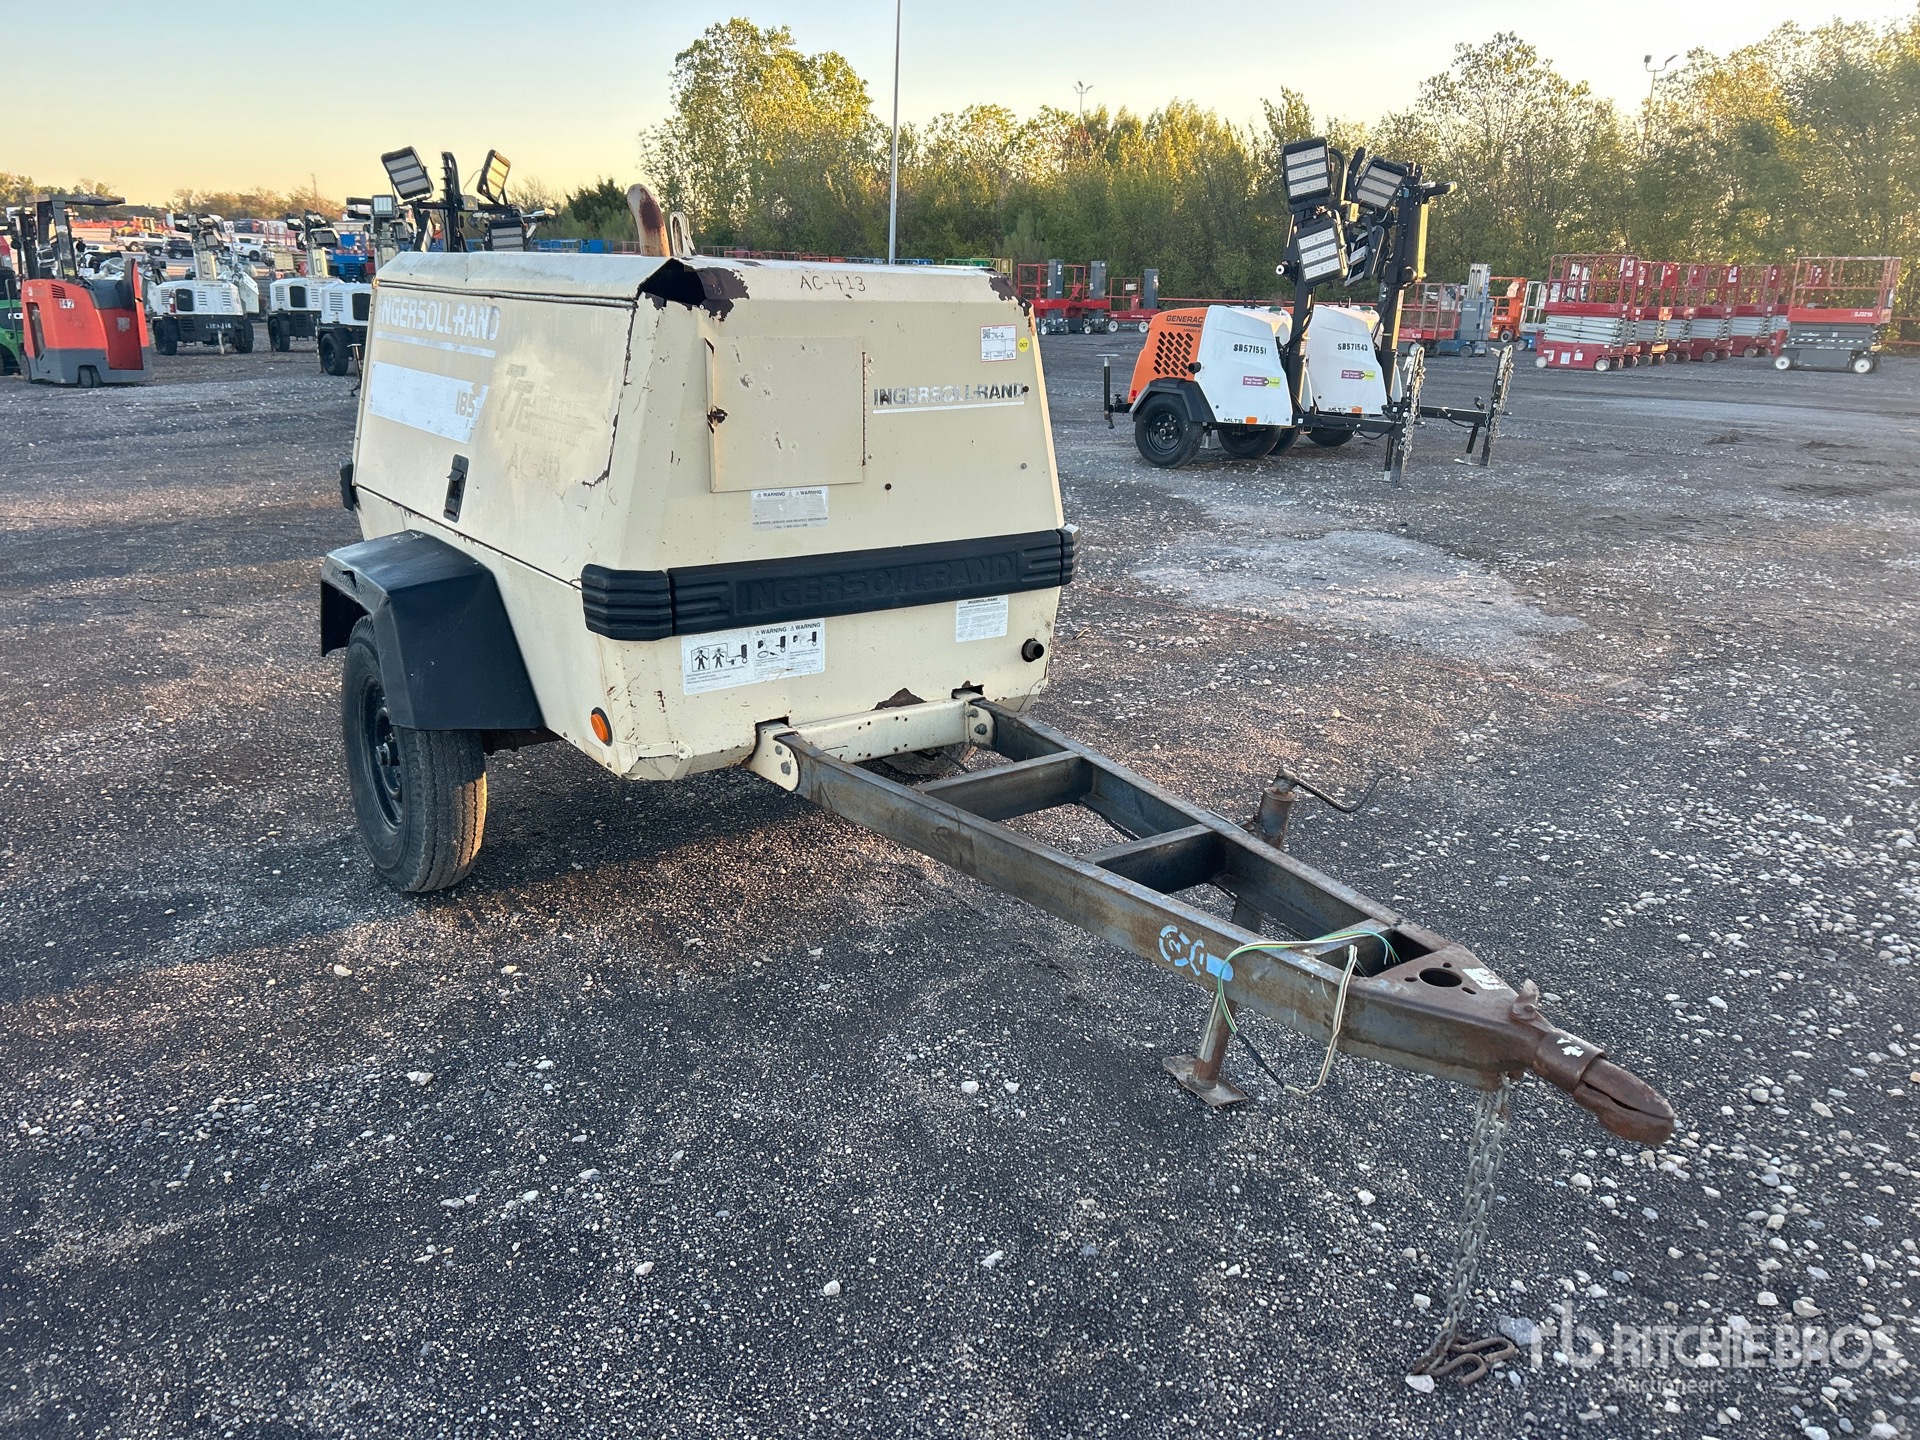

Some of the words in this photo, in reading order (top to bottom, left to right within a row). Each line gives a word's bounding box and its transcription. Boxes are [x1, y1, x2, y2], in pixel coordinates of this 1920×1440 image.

[800, 275, 866, 292] AC-413
[377, 294, 500, 341] INGERSOLL-RAND
[1166, 315, 1204, 324] GENERAC
[1233, 343, 1267, 355] SB571551
[873, 382, 1025, 407] INGERSOLL-RAND
[455, 390, 476, 417] 185
[760, 626, 787, 635] WARNING
[795, 621, 821, 631] WARNING
